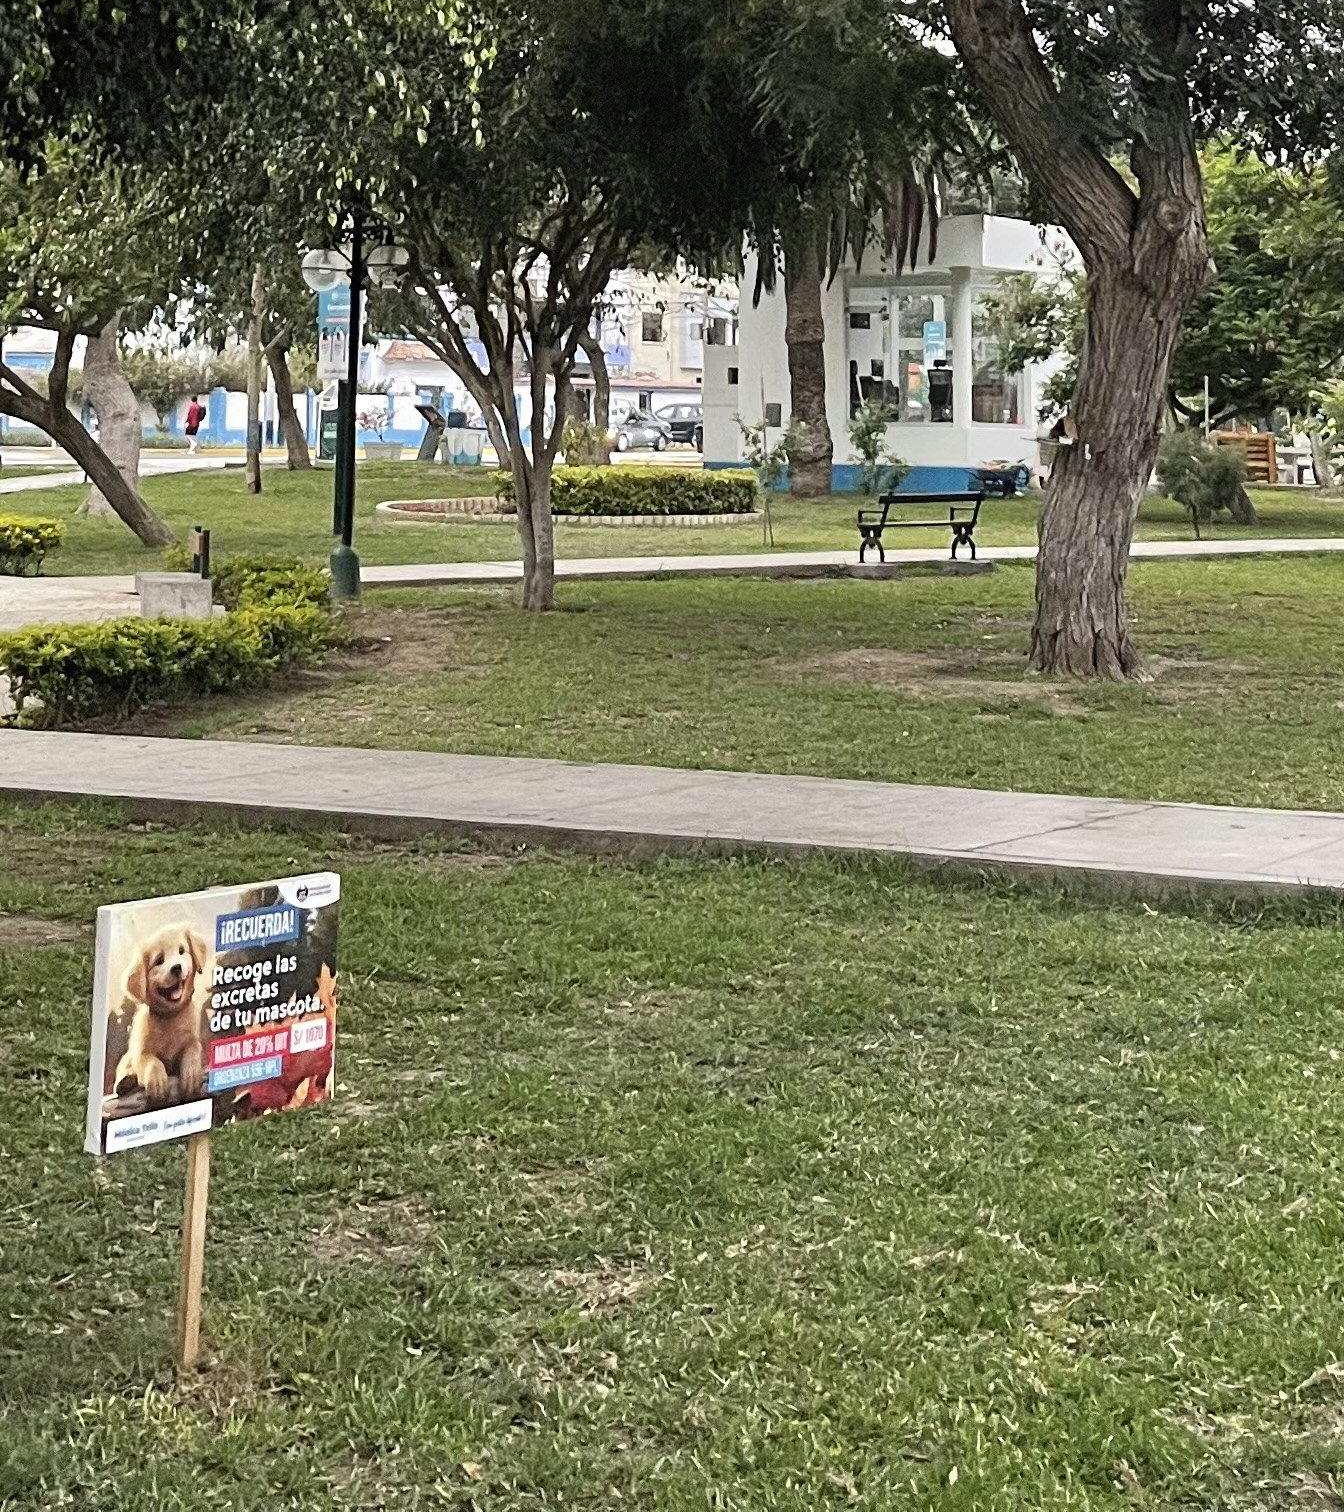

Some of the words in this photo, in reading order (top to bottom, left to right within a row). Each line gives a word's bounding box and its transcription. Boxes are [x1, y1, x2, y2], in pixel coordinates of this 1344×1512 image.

[220, 909, 295, 945] ¡RECUERDA!
[212, 959, 272, 986] Recoge
[275, 954, 297, 974] las
[211, 980, 279, 1009] excretas
[209, 1011, 232, 1033] de
[234, 1008, 251, 1027] tu
[255, 994, 325, 1023] mascota.
[214, 1040, 242, 1065] MULTA
[242, 1038, 255, 1058] DE
